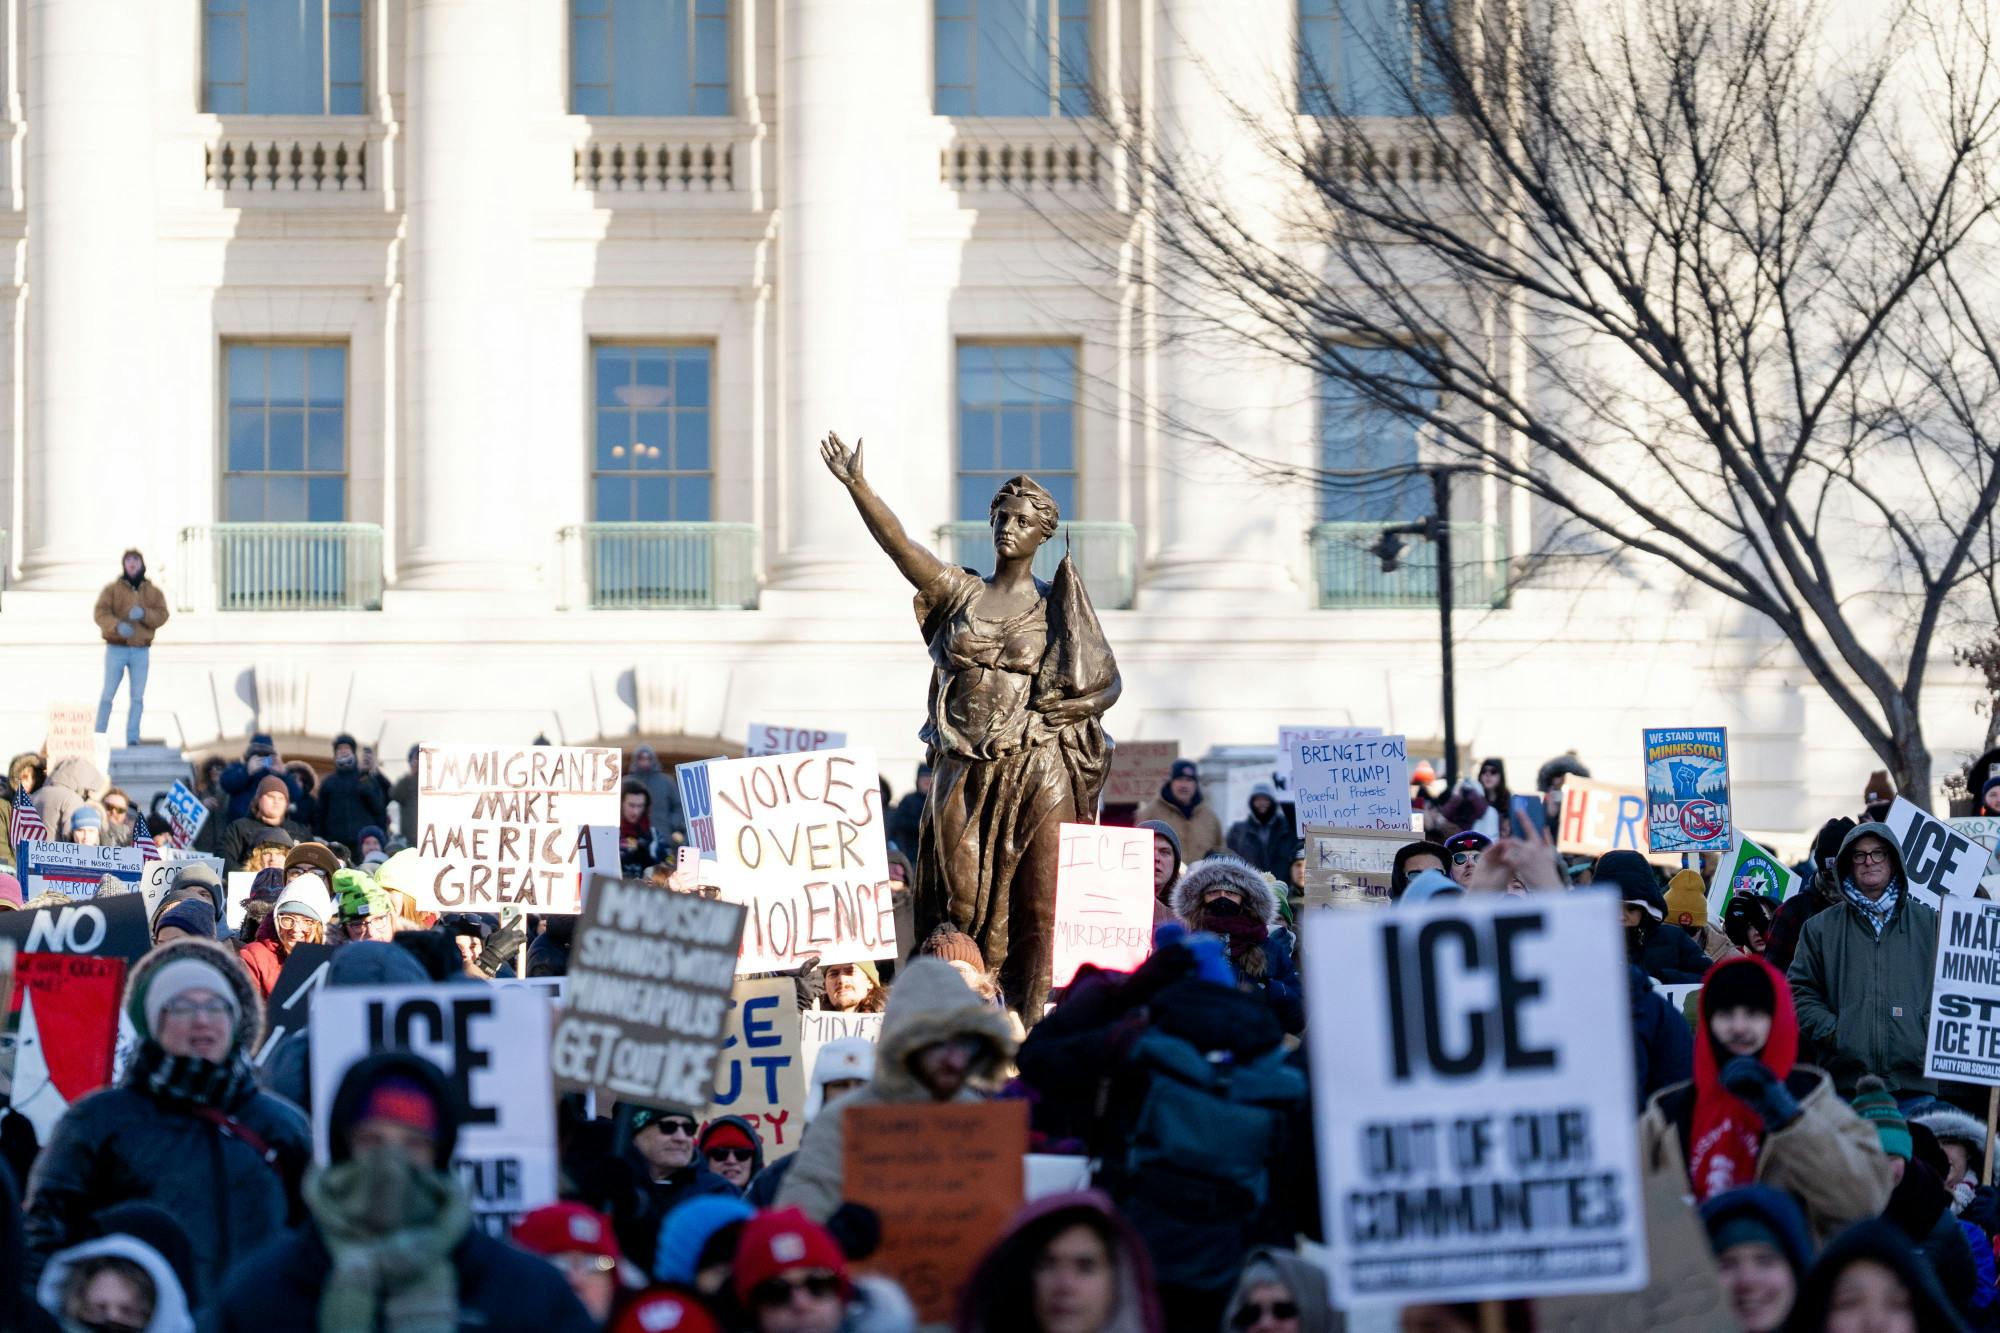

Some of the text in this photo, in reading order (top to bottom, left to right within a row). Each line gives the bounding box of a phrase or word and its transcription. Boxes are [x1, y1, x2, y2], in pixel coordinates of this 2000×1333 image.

[764, 727, 827, 752] STOP
[1302, 740, 1406, 764] BRING IT ON,
[1648, 743, 1723, 762] MINNESOTA!
[1649, 731, 1720, 744] WE STAND WITH
[420, 748, 620, 791] IMMIGRANTS
[1328, 765, 1391, 784] TRUMP!
[168, 783, 203, 823] ICE
[472, 791, 560, 824] MAKE
[718, 757, 880, 826] VOICES
[1299, 785, 1386, 805] Peaceful Protests
[1302, 805, 1327, 819] will
[1333, 804, 1360, 819] not
[1563, 789, 1649, 849] HER
[1652, 803, 1679, 823] NO
[31, 853, 141, 871] PROSECUTE THE MASKED THUGS
[35, 841, 122, 861] ABOLISH ICE
[419, 824, 595, 868] AMERICA
[738, 821, 864, 870] OVER
[1060, 834, 1146, 872] ICE
[1902, 811, 1970, 896] ICE
[24, 904, 107, 954] NO
[738, 880, 895, 961] IOLENCE
[1054, 921, 1153, 952] MURDERERS
[1380, 911, 1559, 1083] ICE
[1934, 1020, 2000, 1059] ICE TE
[553, 1016, 622, 1086] GET
[657, 1040, 718, 1106] ICE
[1933, 1057, 1957, 1072] PARTY
[1956, 1060, 1971, 1073] FOR
[712, 1055, 793, 1106] UT
